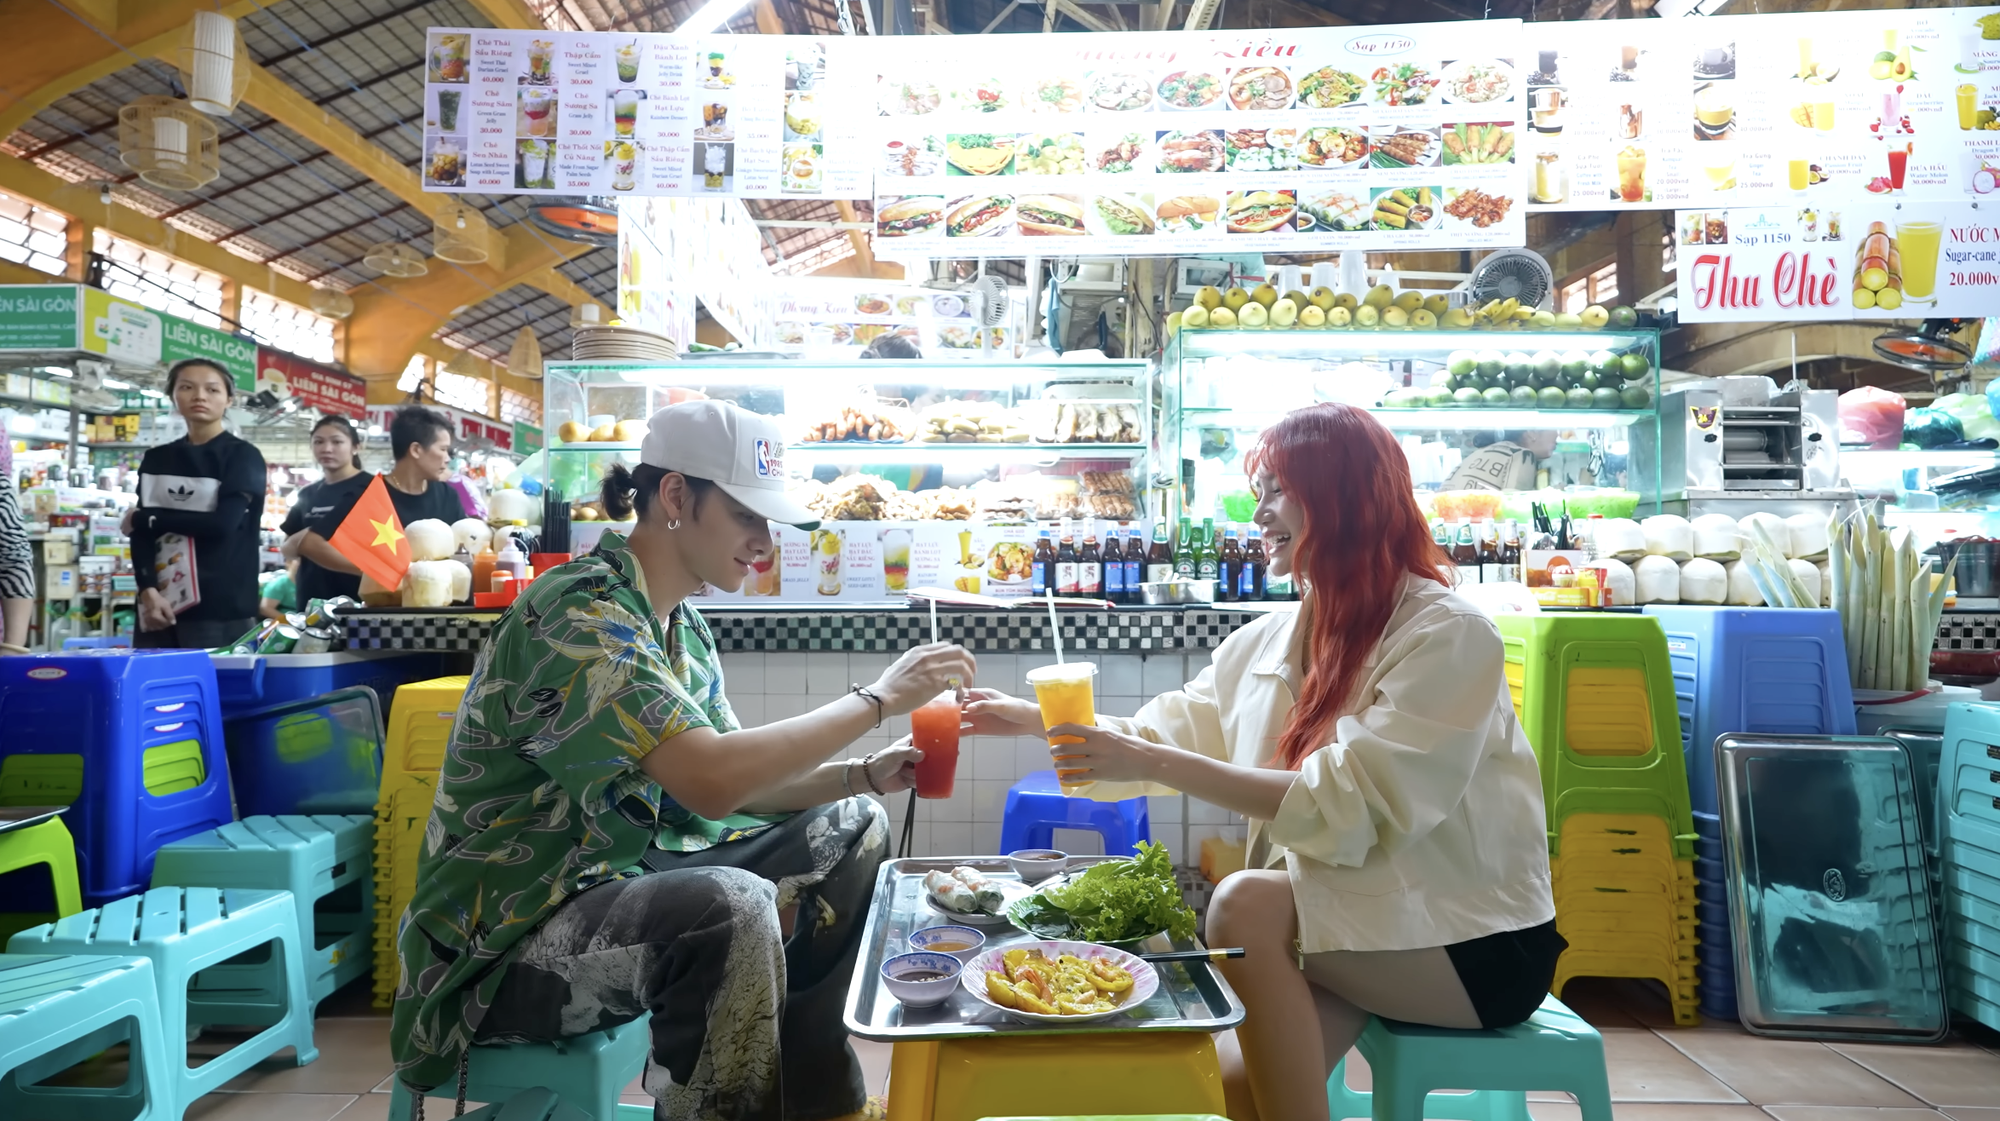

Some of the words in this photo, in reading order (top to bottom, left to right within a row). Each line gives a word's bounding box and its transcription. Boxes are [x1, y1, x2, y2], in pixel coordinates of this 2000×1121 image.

[1352, 41, 1377, 52] Sạp
[1384, 40, 1412, 49] 1150
[1735, 233, 1759, 247] Sạp
[1763, 232, 1792, 244] 1150
[1950, 223, 1989, 243] NƯỚC
[1945, 248, 1996, 265] Sugar-cane
[1690, 253, 1765, 311] Thu
[1772, 249, 1841, 309] Chè
[16, 296, 40, 312] SÀI
[42, 296, 76, 312] GÒN
[164, 323, 197, 346] LIÊN
[200, 333, 223, 354] SÀI
[224, 341, 255, 364] GÒN
[293, 376, 318, 393] LIÊN
[321, 384, 339, 399] SÀI
[341, 391, 365, 407] GÒN
